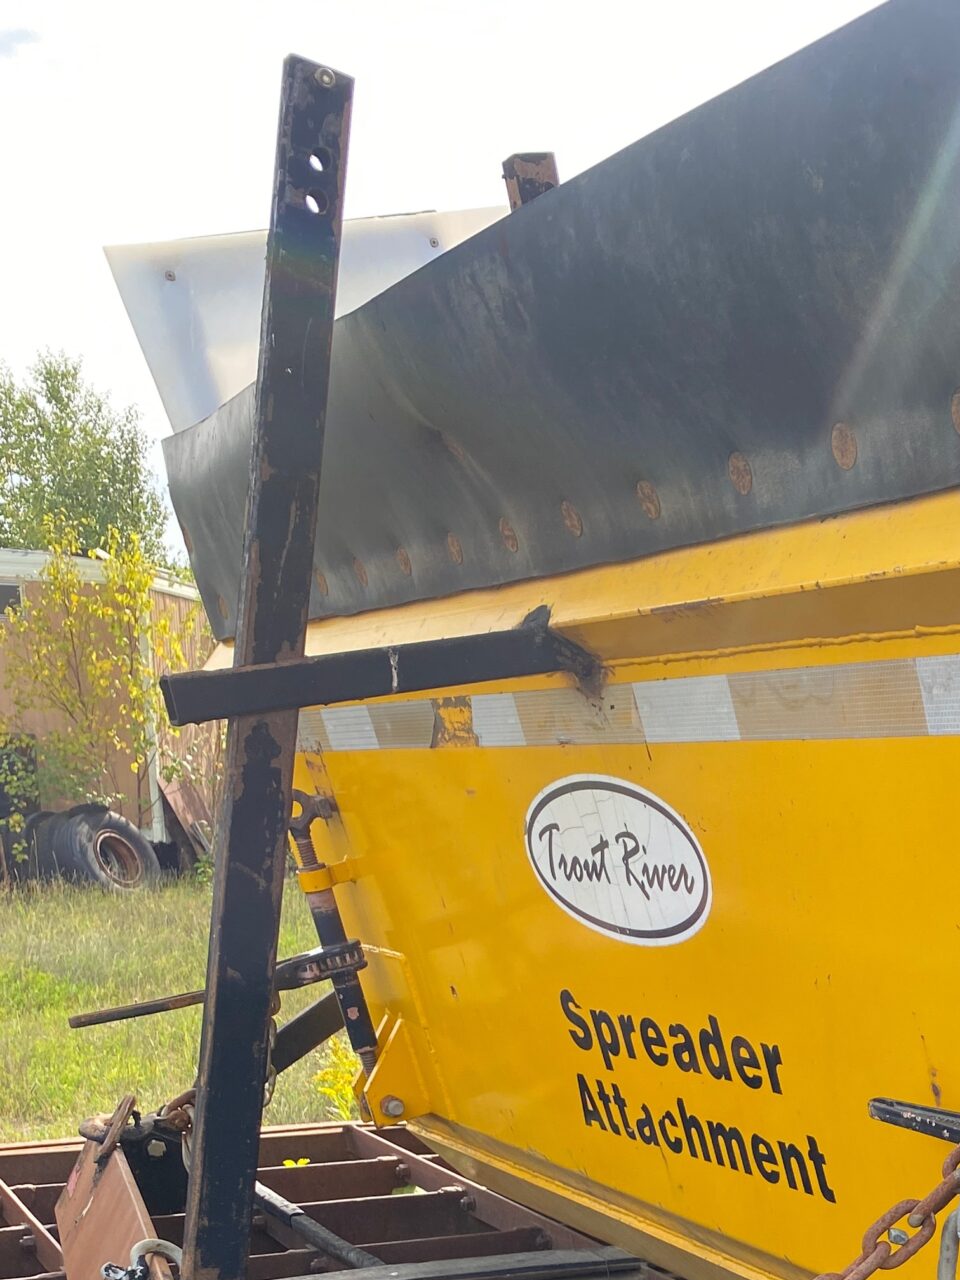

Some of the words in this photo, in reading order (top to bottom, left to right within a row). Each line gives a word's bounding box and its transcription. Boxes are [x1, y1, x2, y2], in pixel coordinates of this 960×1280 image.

[538, 822, 612, 885] Trout
[614, 831, 695, 901] River
[559, 988, 783, 1096] Spreader
[576, 1072, 837, 1204] Attachment
